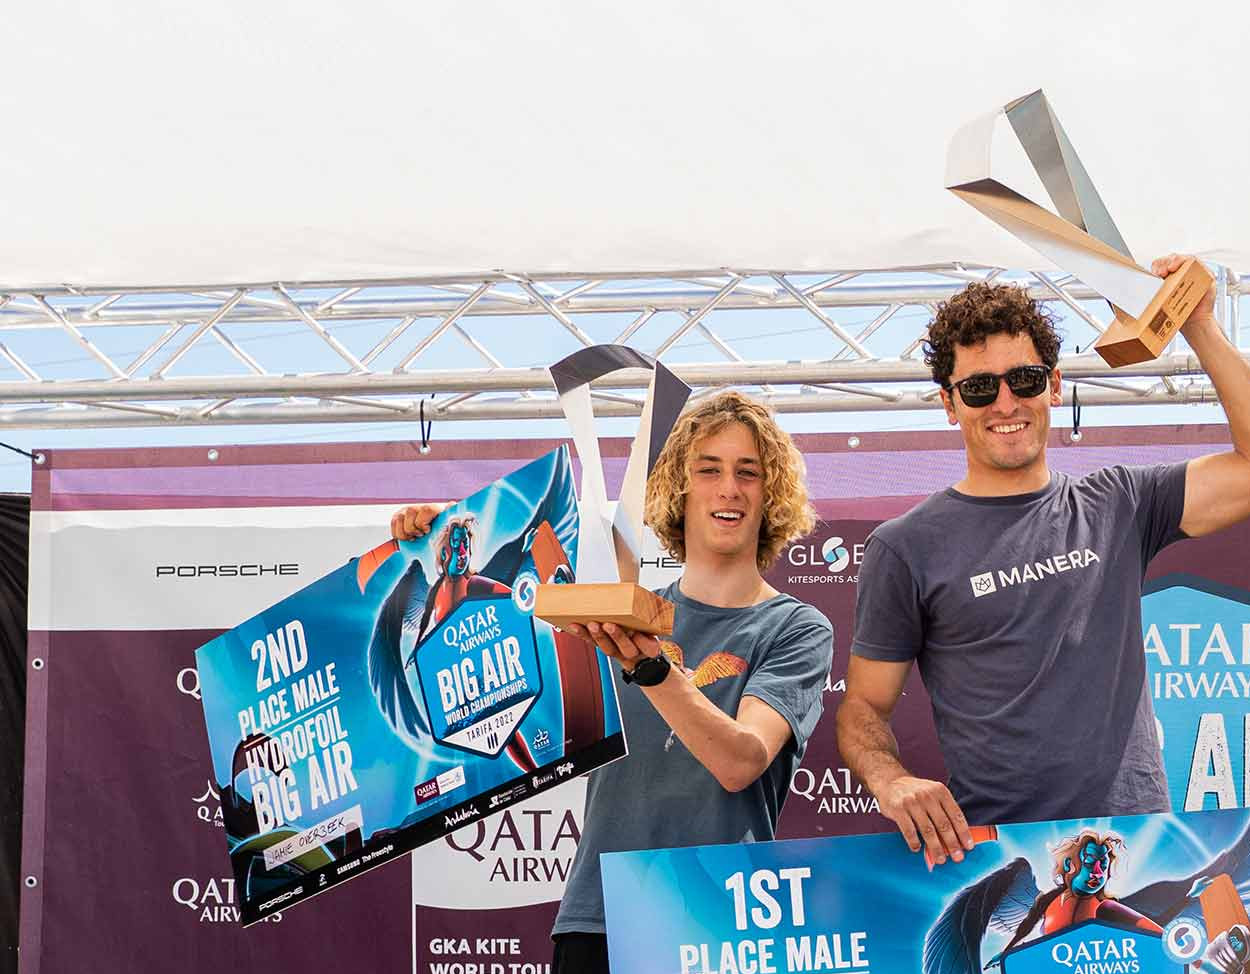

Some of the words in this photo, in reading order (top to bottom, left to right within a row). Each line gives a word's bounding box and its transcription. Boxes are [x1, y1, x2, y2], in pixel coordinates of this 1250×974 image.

[156, 564, 299, 577] PORSCHE
[788, 576, 844, 584] KITESPORTS
[998, 549, 1100, 587] MANERA
[443, 605, 498, 647] QATAR
[460, 625, 501, 654] AIRWAYS
[251, 620, 308, 692] 2ND
[437, 658, 479, 712] BIG
[482, 636, 525, 692] AIR
[238, 689, 291, 741] PLACE
[292, 662, 340, 713] MALE
[445, 706, 469, 725] WORLD
[471, 678, 527, 714] CHAMPIONSHIPS
[467, 722, 492, 742] TARIFA
[495, 712, 514, 727] 2022
[246, 706, 348, 783] HYDROFOIL
[252, 768, 302, 835] BIG
[308, 741, 358, 810] AIR
[416, 781, 436, 797] QATAR
[790, 768, 861, 800] QAT
[818, 797, 880, 813] AIRWA
[445, 810, 582, 862] QATA
[490, 857, 572, 882] AIRW
[172, 878, 235, 910] QAT
[259, 886, 303, 911] PORSCHE
[725, 867, 811, 930] 1ST
[430, 938, 471, 954] GKA
[476, 938, 520, 954] KITE
[786, 932, 870, 972] MALE
[1052, 938, 1138, 967] QATAR
